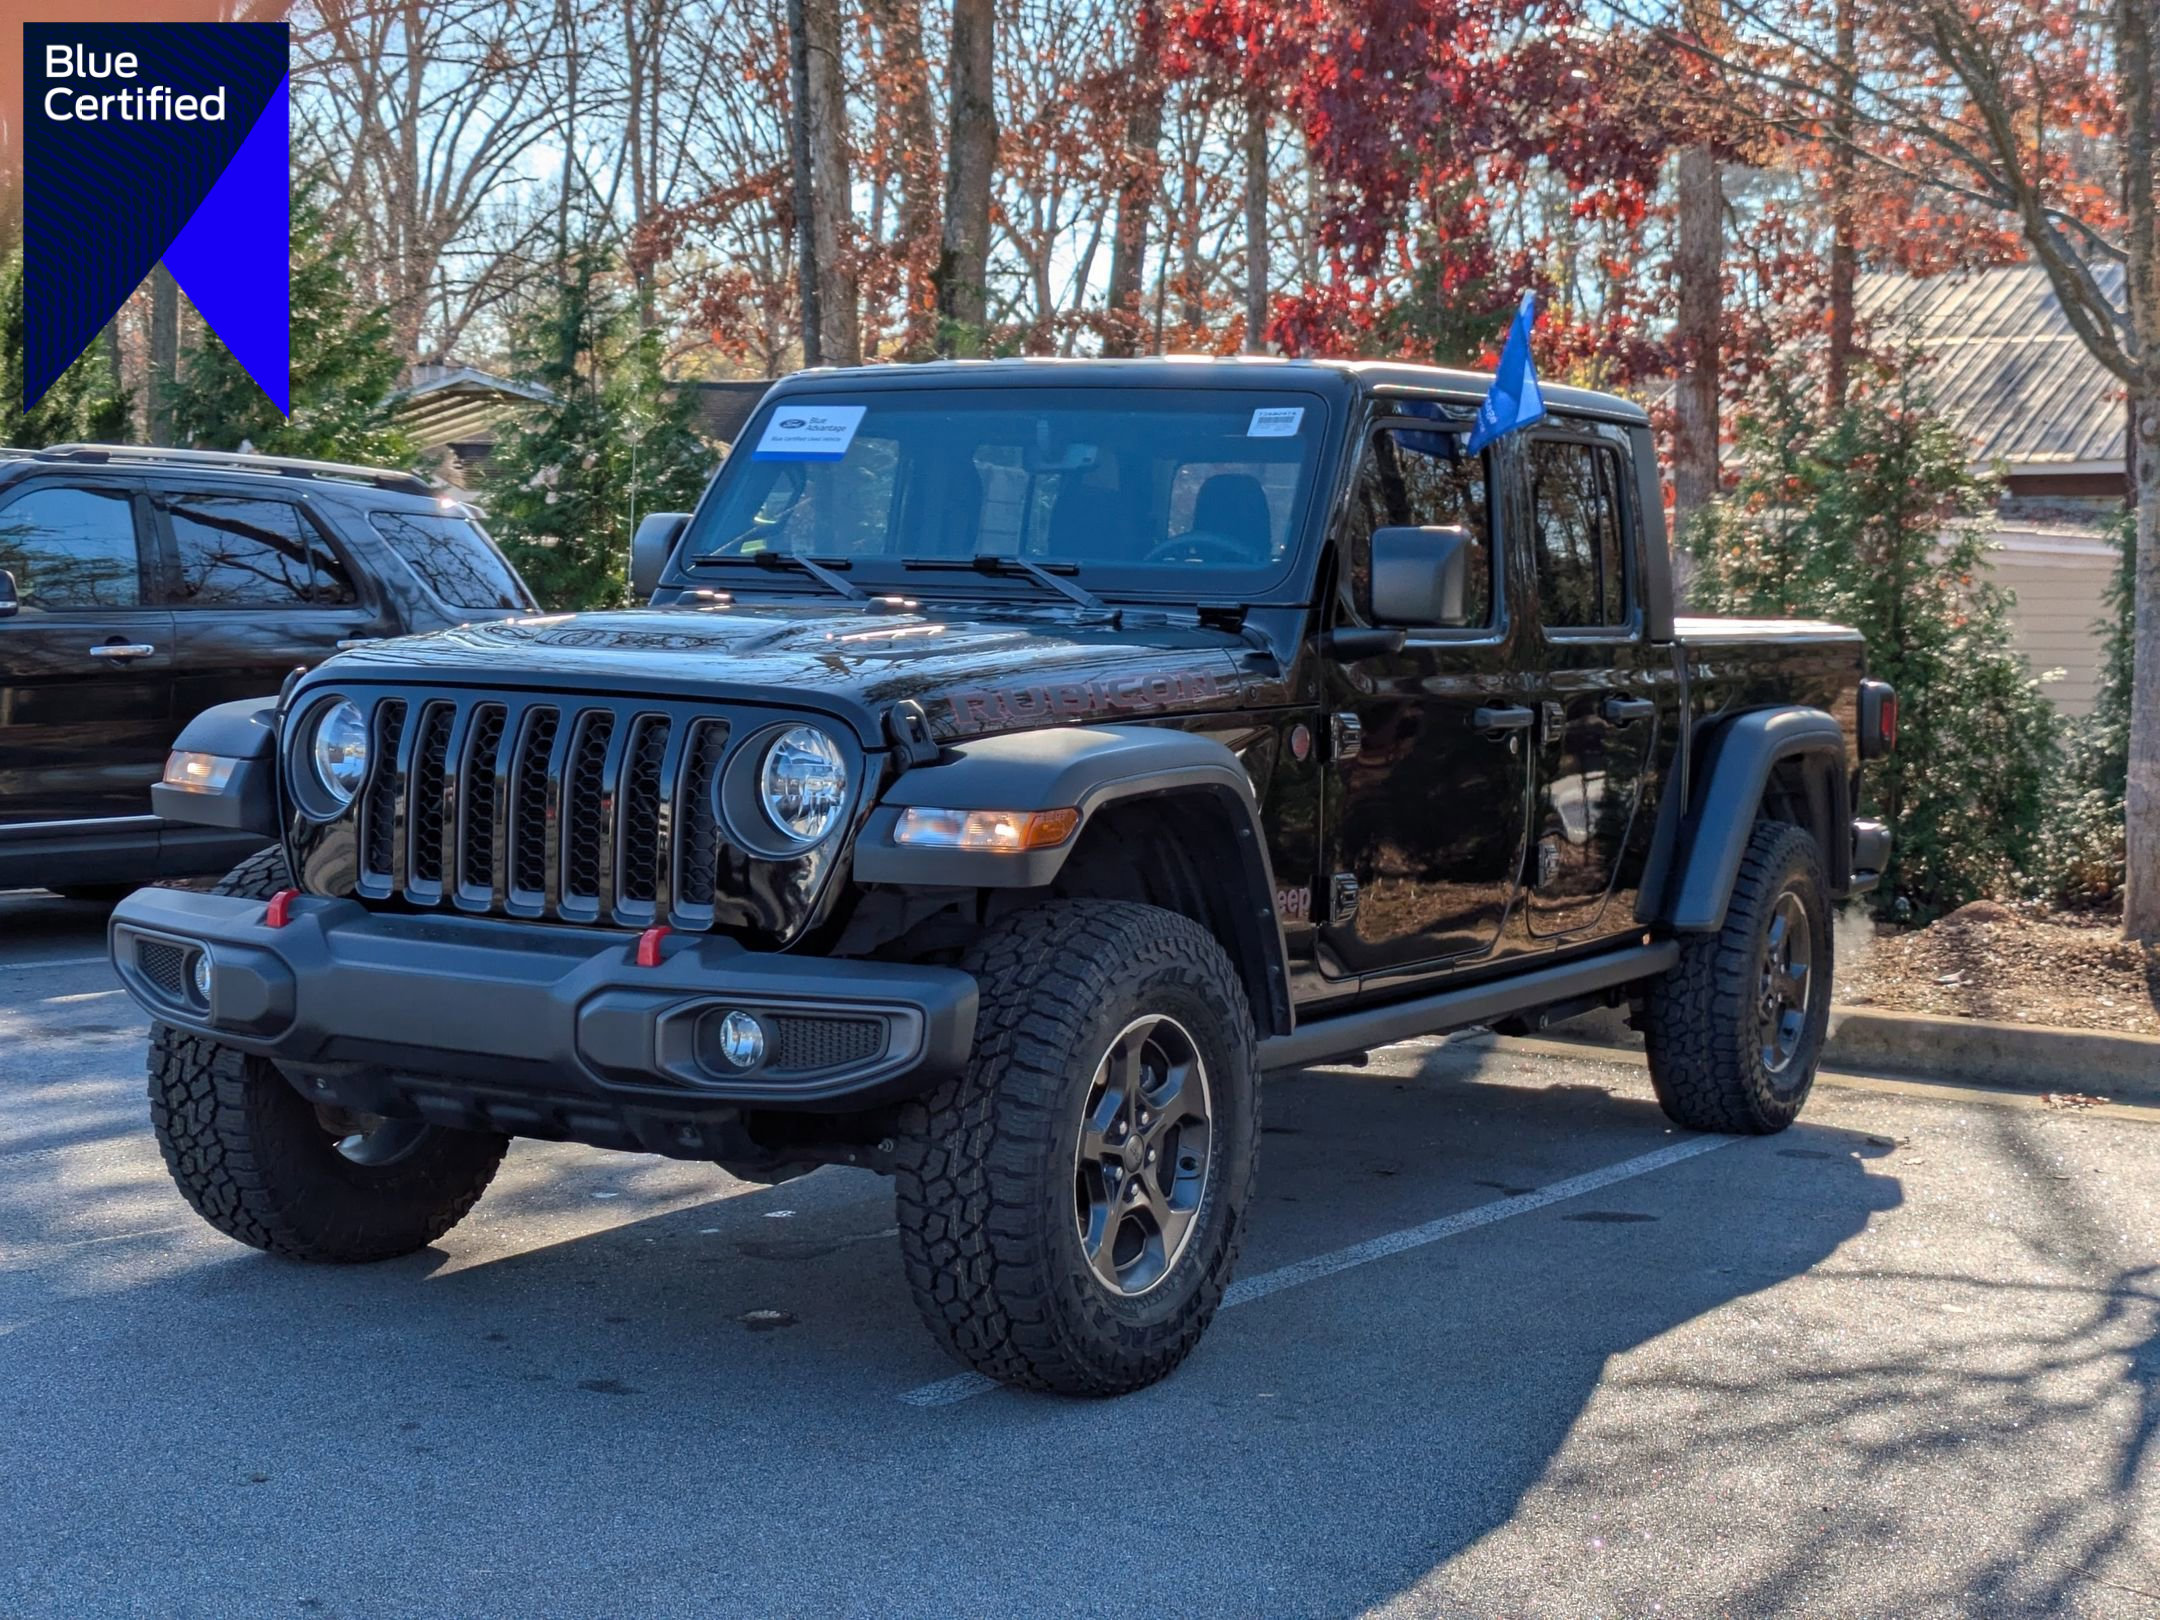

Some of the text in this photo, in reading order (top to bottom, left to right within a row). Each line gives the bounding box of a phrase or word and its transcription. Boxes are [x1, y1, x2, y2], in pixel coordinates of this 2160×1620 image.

[806, 424, 847, 433] Advantage
[948, 669, 1219, 725] RUBICON
[1276, 887, 1312, 918] eep
